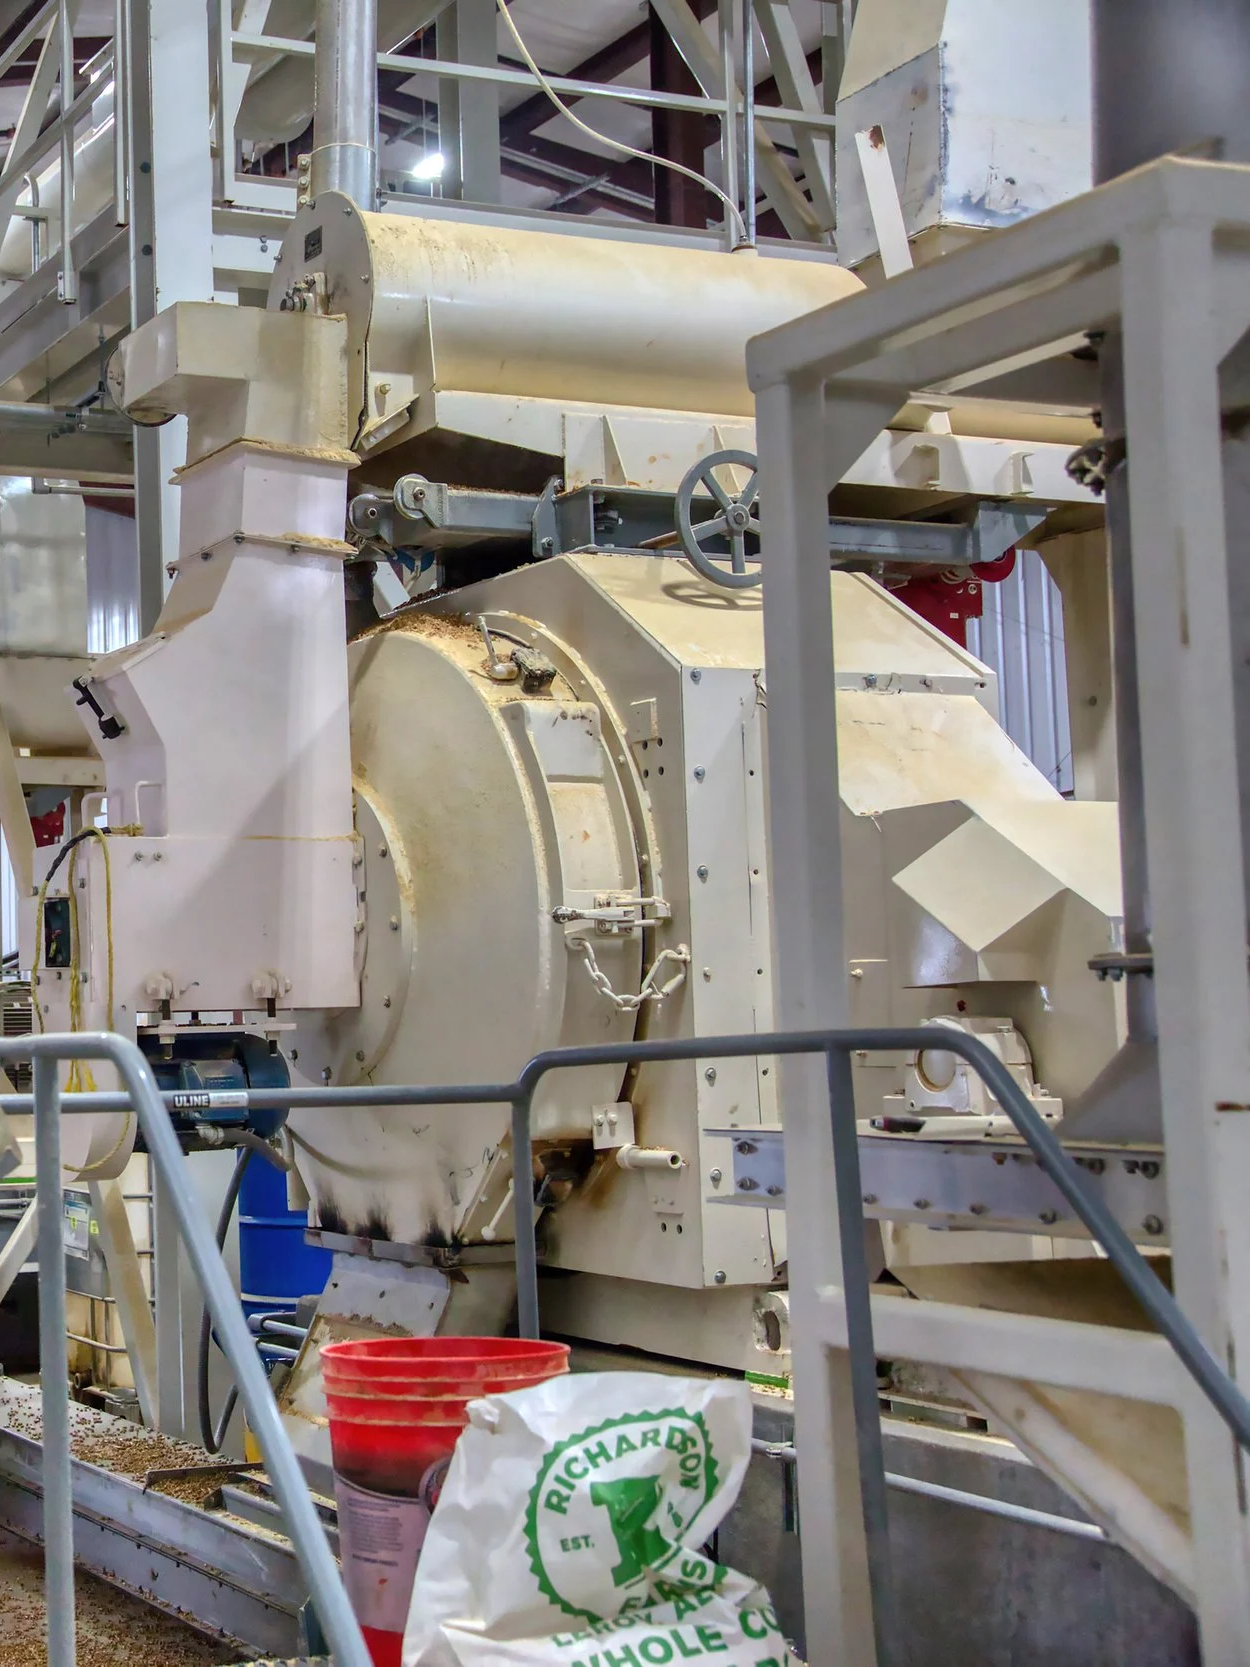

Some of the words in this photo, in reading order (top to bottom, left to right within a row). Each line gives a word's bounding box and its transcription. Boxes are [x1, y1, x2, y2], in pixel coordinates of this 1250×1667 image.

[174, 1094, 209, 1108] ULINE
[543, 1425, 702, 1516] RICHARDSON
[560, 1534, 595, 1553] EST.
